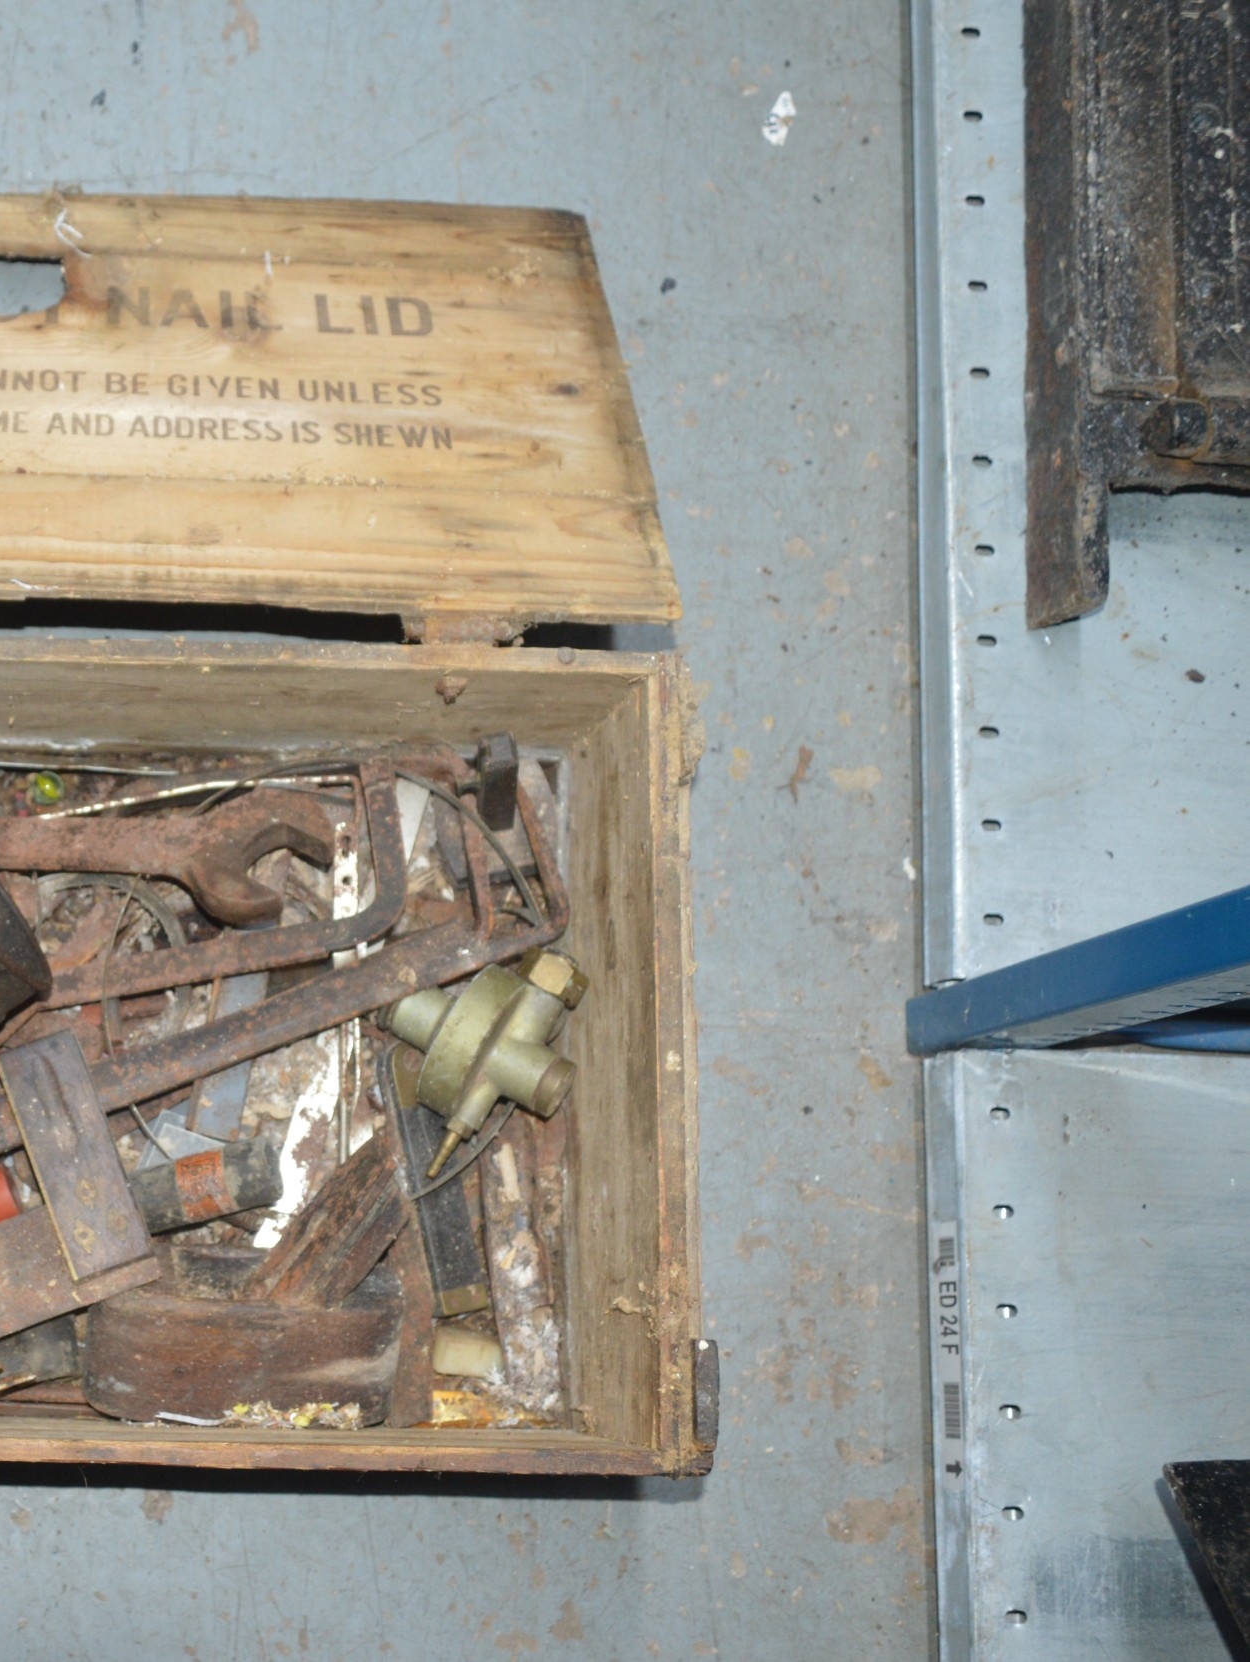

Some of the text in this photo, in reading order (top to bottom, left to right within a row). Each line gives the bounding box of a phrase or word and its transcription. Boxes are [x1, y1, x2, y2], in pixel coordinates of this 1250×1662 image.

[105, 285, 284, 331] NAIL
[314, 293, 434, 337] LID
[104, 372, 149, 395] BE
[166, 374, 281, 400] GIVEN
[297, 378, 443, 406] UNLESS
[45, 411, 115, 437] AND
[127, 415, 284, 443] ADDRESS
[291, 421, 322, 444] IS
[333, 423, 453, 450] SHEWN
[938, 1281, 959, 1355] ED 24 F
